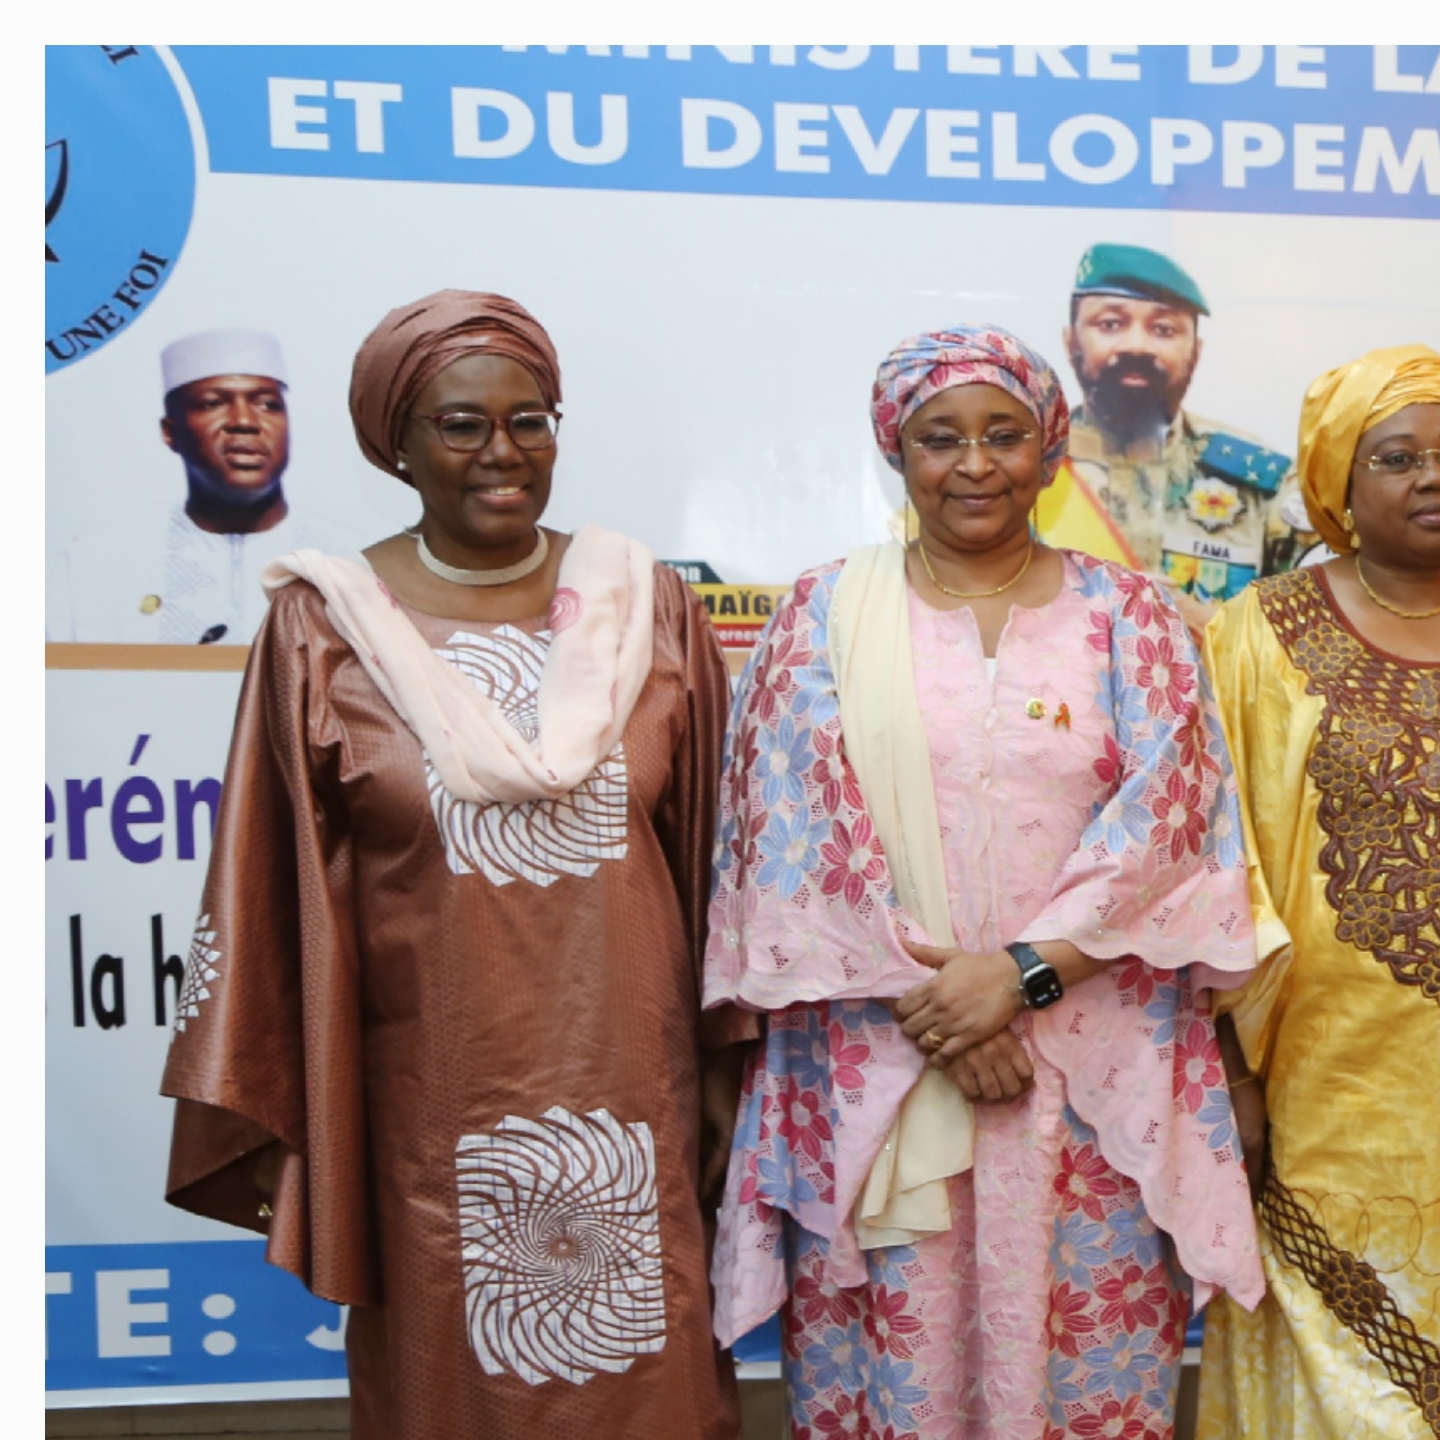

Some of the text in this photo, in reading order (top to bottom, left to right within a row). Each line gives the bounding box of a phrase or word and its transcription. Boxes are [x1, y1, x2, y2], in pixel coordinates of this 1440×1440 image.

[267, 76, 402, 154] ET
[450, 86, 629, 166] DU
[46, 248, 170, 361] UNE FOI
[45, 734, 223, 864] rén
[69, 912, 127, 1030] la
